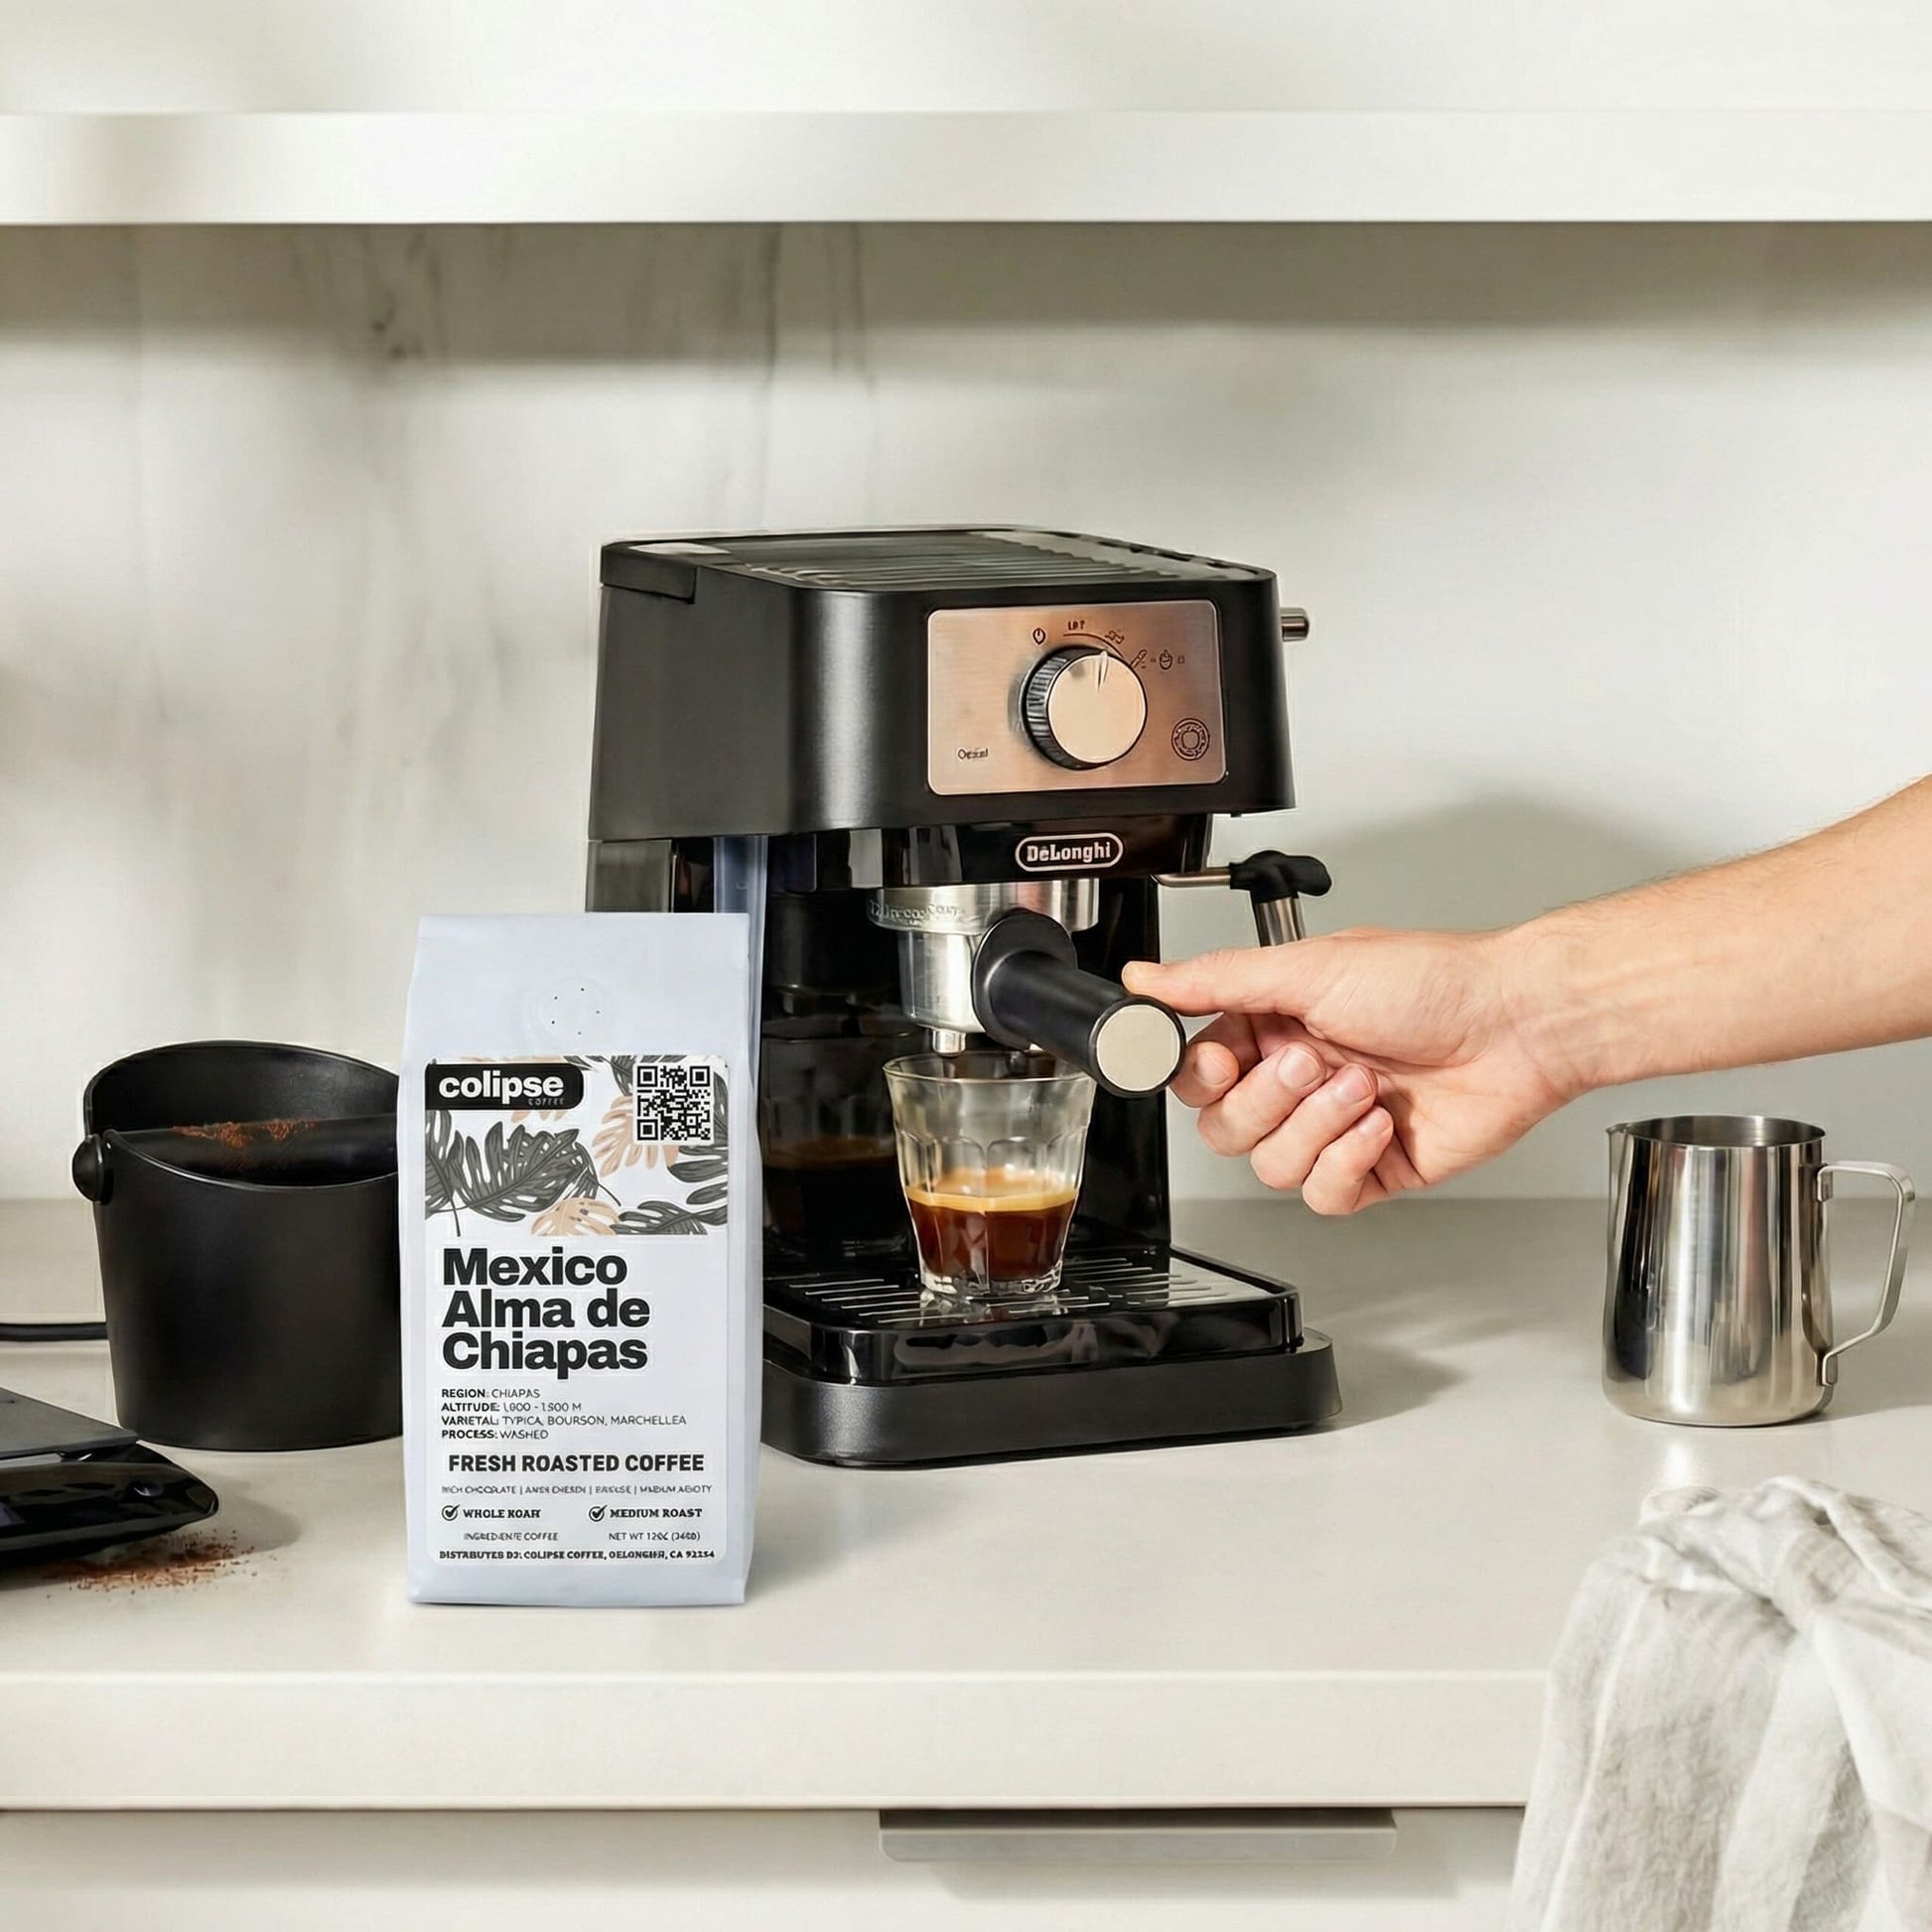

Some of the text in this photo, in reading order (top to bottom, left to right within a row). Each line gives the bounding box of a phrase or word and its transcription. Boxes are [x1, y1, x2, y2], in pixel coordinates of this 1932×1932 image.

[1027, 842, 1111, 863] DeLonghi
[439, 1070, 564, 1104] colipse
[444, 1246, 627, 1286] Mexico
[442, 1288, 650, 1327] Alma de
[443, 1331, 647, 1379] Chiapas
[491, 1389, 540, 1398] CHIAPAS
[442, 1430, 497, 1439] PROCESS:
[449, 1454, 705, 1472] FRESH ROASTED COFFEE
[463, 1509, 504, 1518] WHOLE
[610, 1509, 702, 1518] MEDIUM ROAST
[670, 1550, 683, 1559] CA
